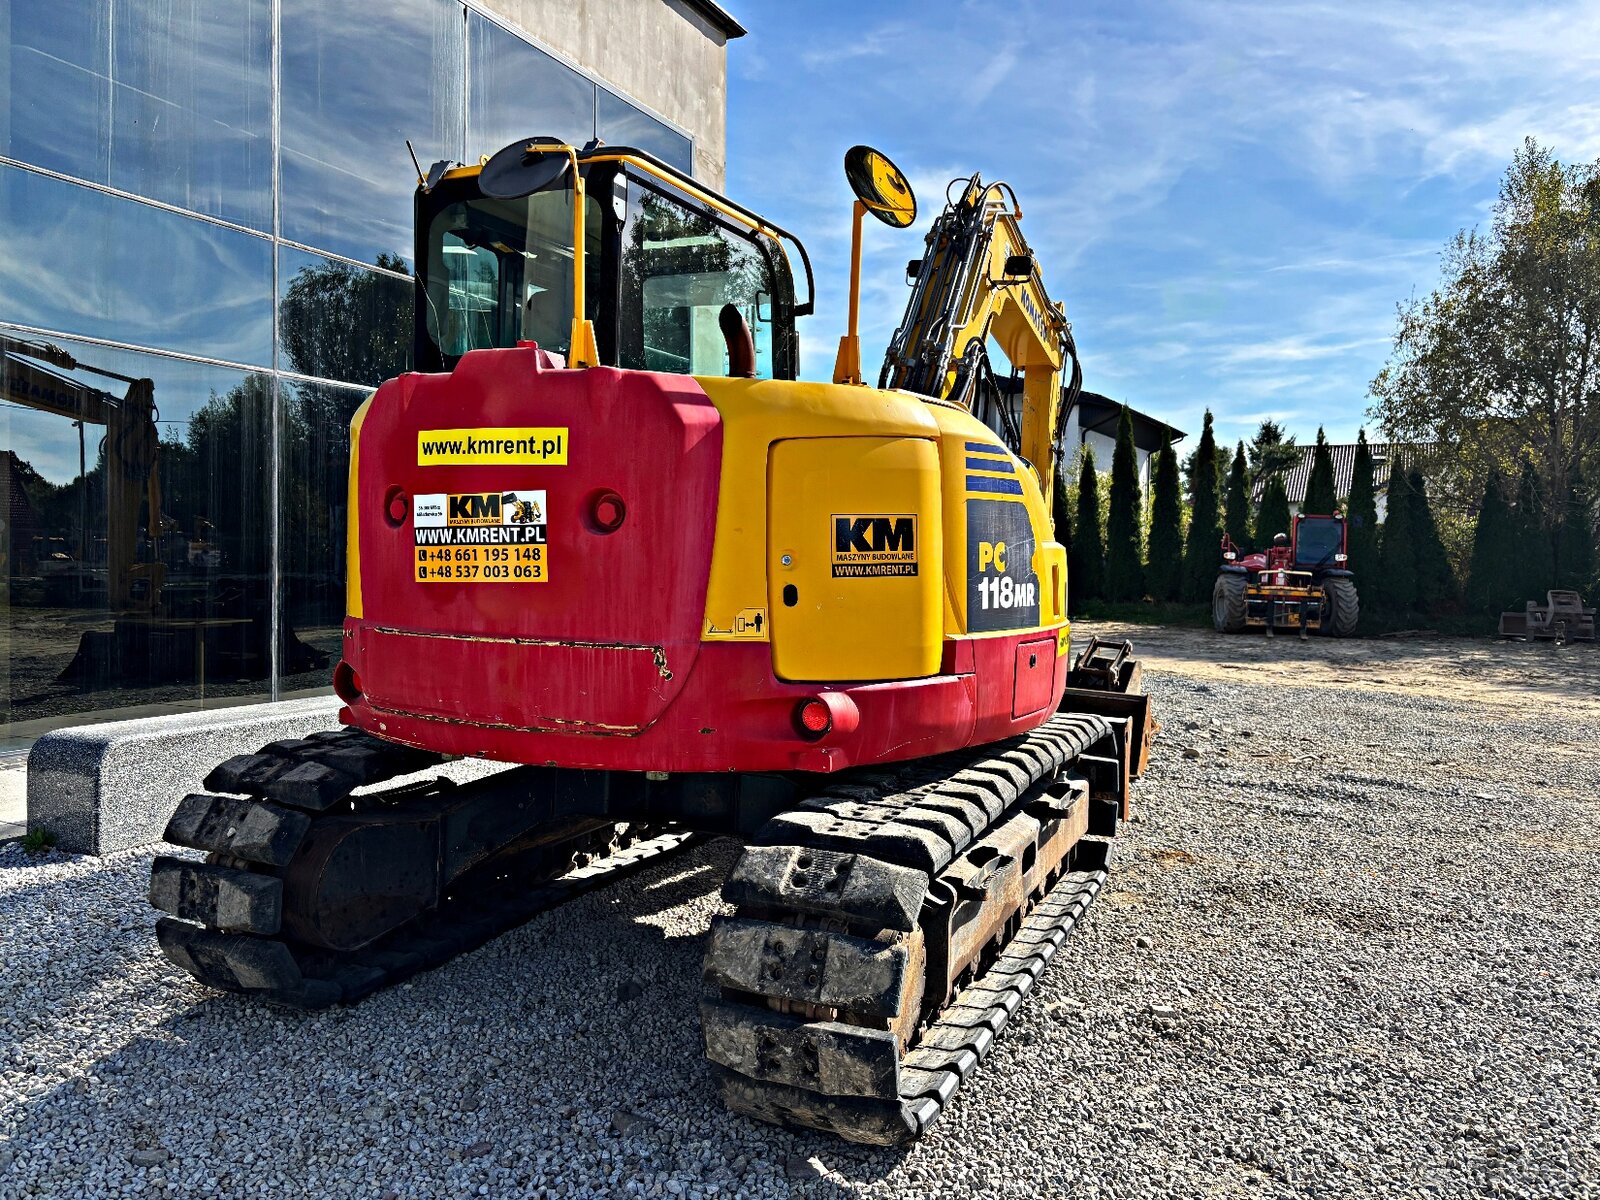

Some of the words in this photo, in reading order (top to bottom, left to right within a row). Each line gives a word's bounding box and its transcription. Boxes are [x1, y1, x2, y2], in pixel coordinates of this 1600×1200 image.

[422, 435, 561, 459] www.kmrent.pl
[450, 495, 500, 518] KM
[415, 527, 545, 544] WWW.KMRENT.PL
[836, 518, 914, 552] KM
[429, 550, 452, 562] +48
[455, 549, 478, 561] 661
[484, 549, 509, 561] 195
[515, 548, 541, 561] 148
[978, 541, 1006, 573] PC
[429, 567, 452, 578] +48
[455, 566, 479, 578] 537
[484, 566, 509, 578] 003
[514, 566, 541, 578] 063
[835, 565, 916, 576] WWW.KMRENT.PL
[978, 576, 1035, 610] 118MR
